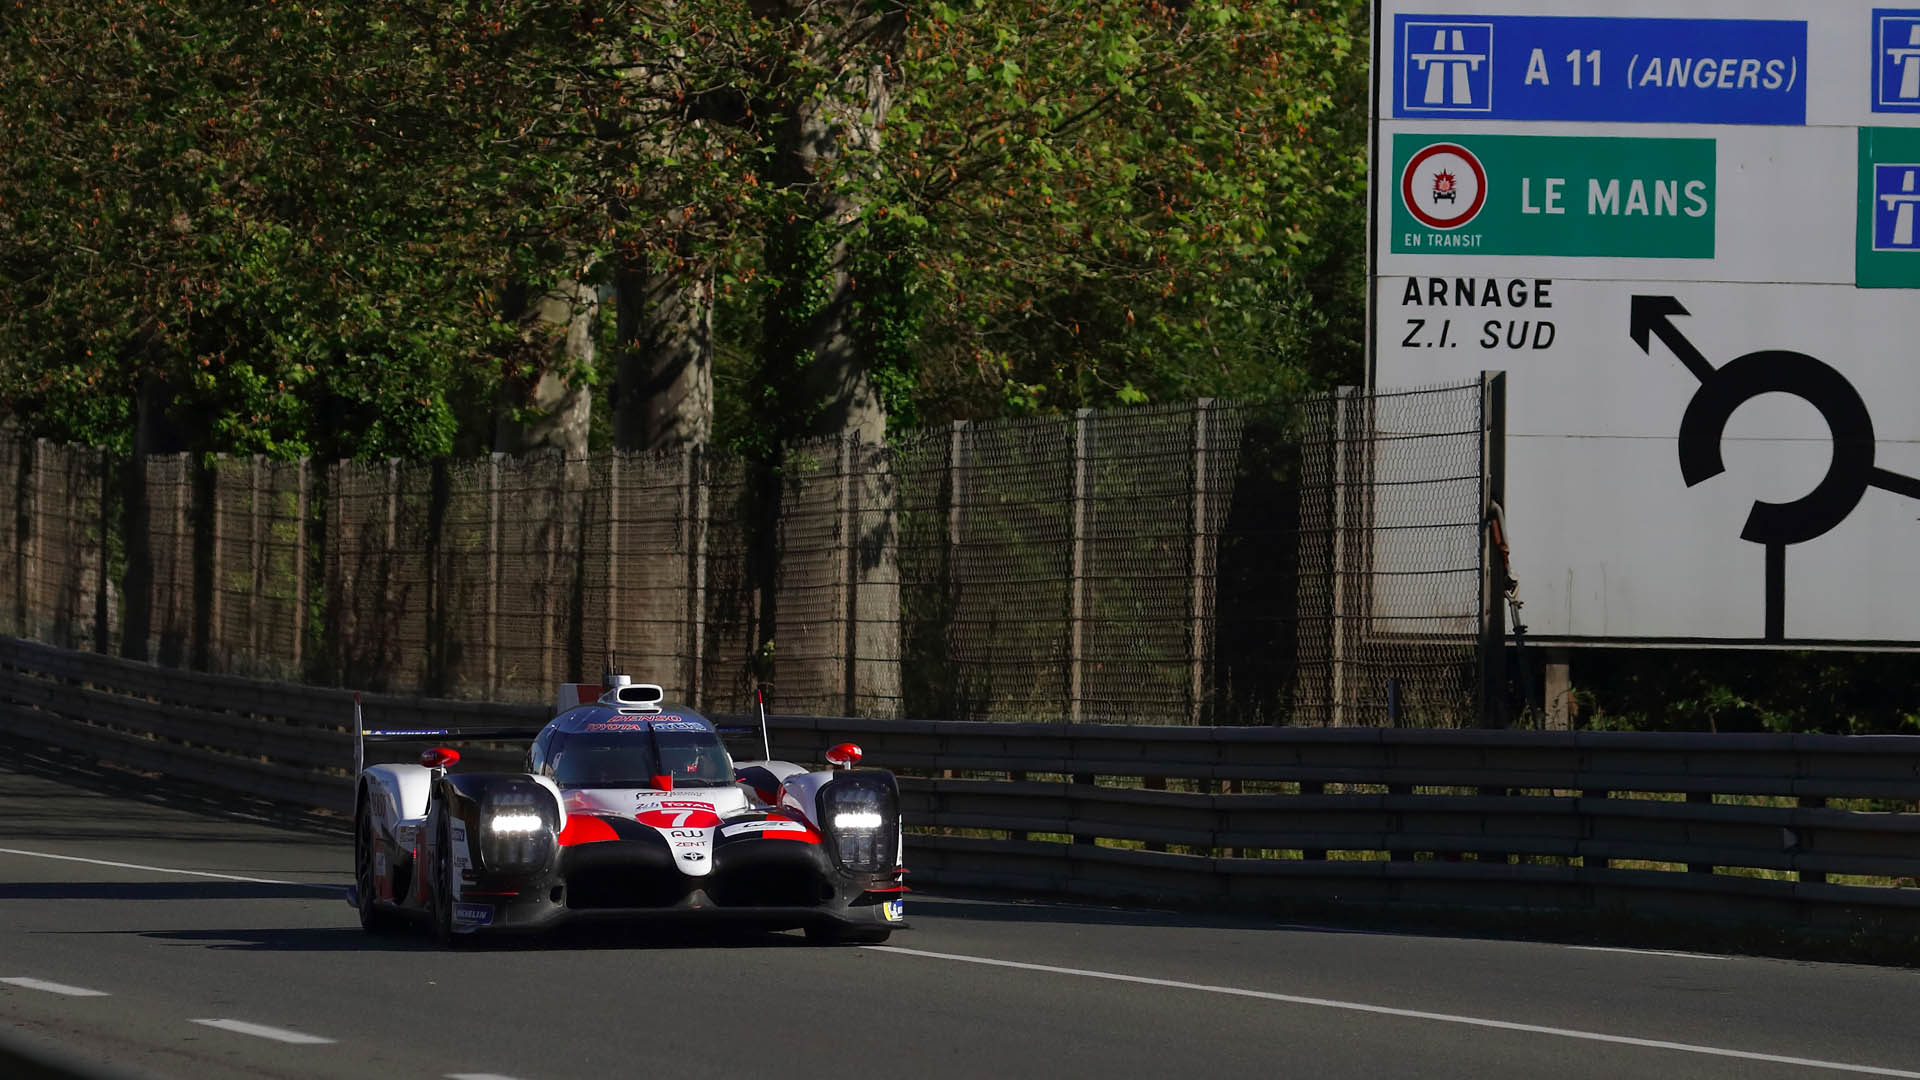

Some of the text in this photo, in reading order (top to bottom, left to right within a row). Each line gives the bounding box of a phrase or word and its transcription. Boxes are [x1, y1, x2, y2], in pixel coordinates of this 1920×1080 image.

[1524, 48, 1798, 92] A 11 (ANGERS)
[1521, 177, 1709, 217] LE MANS
[1404, 233, 1482, 248] EN TRANSIT
[1402, 277, 1553, 308] ARNAGE
[1401, 318, 1556, 350] Z.I. SUD
[607, 714, 682, 723] DENSO
[664, 802, 713, 810] TOTAL
[661, 810, 694, 828] 7
[674, 840, 708, 848] ZENT
